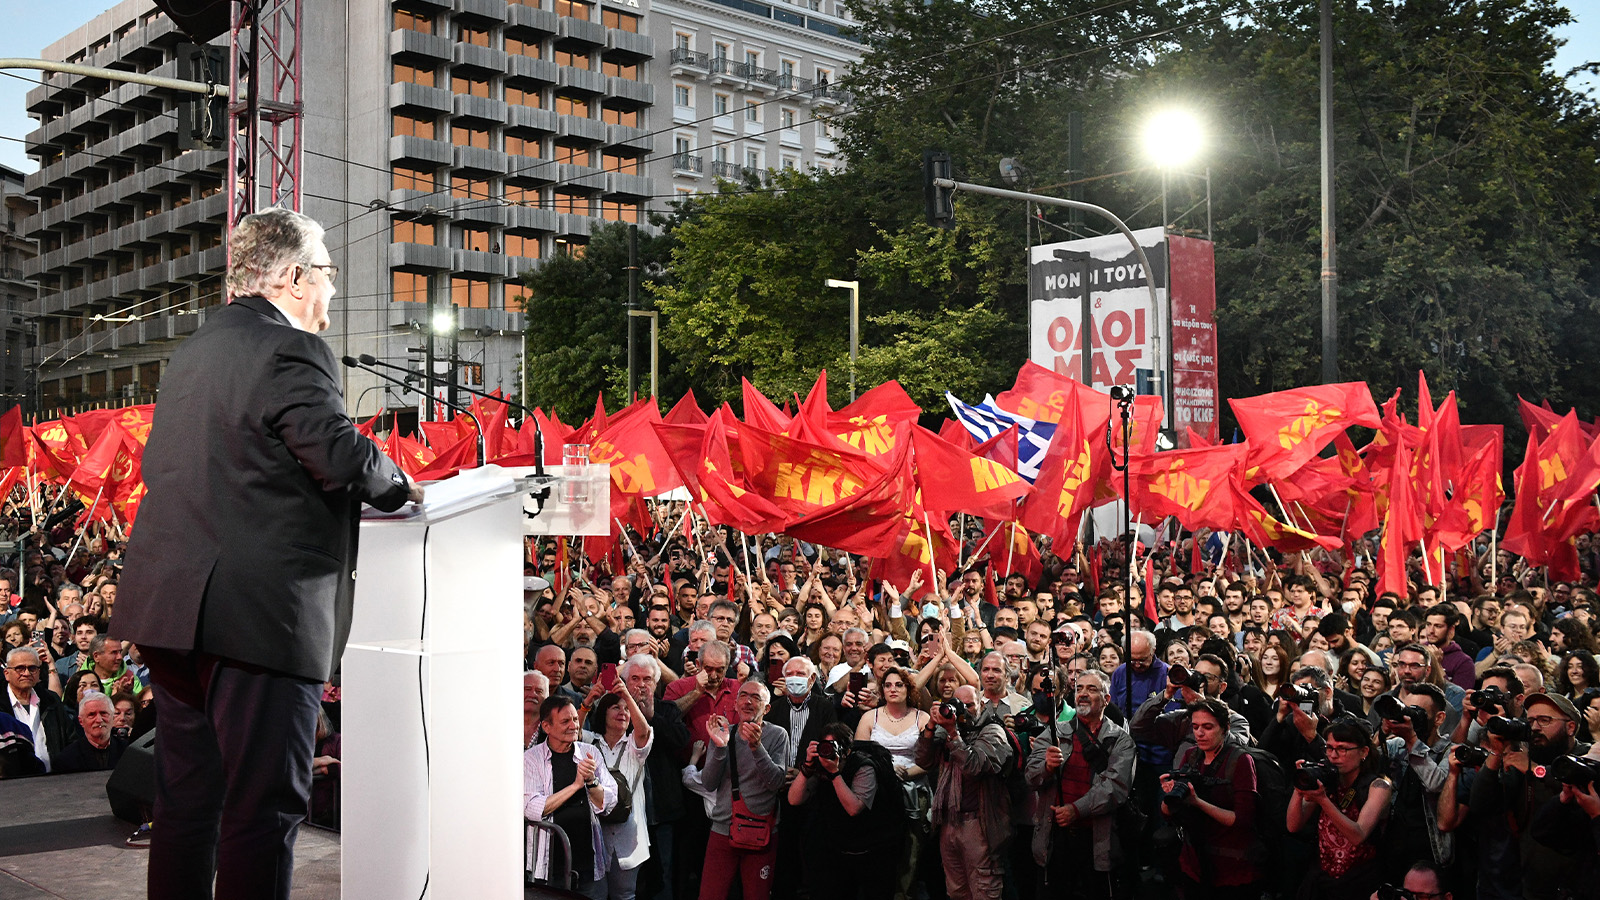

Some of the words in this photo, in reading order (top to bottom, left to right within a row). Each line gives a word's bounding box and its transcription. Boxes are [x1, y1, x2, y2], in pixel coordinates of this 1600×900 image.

[1045, 269, 1099, 291] ΜΟΝΙ
[1104, 263, 1147, 283] ΤΟΥΣ
[1094, 297, 1102, 309] &
[1047, 308, 1146, 353] ΟΛΟΙ
[1200, 322, 1213, 331] τους
[1054, 349, 1142, 387] ΜΑΣ
[1201, 355, 1213, 366] μας
[1175, 407, 1192, 422] ΤΟ
[1193, 407, 1214, 422] ΚΚΕ
